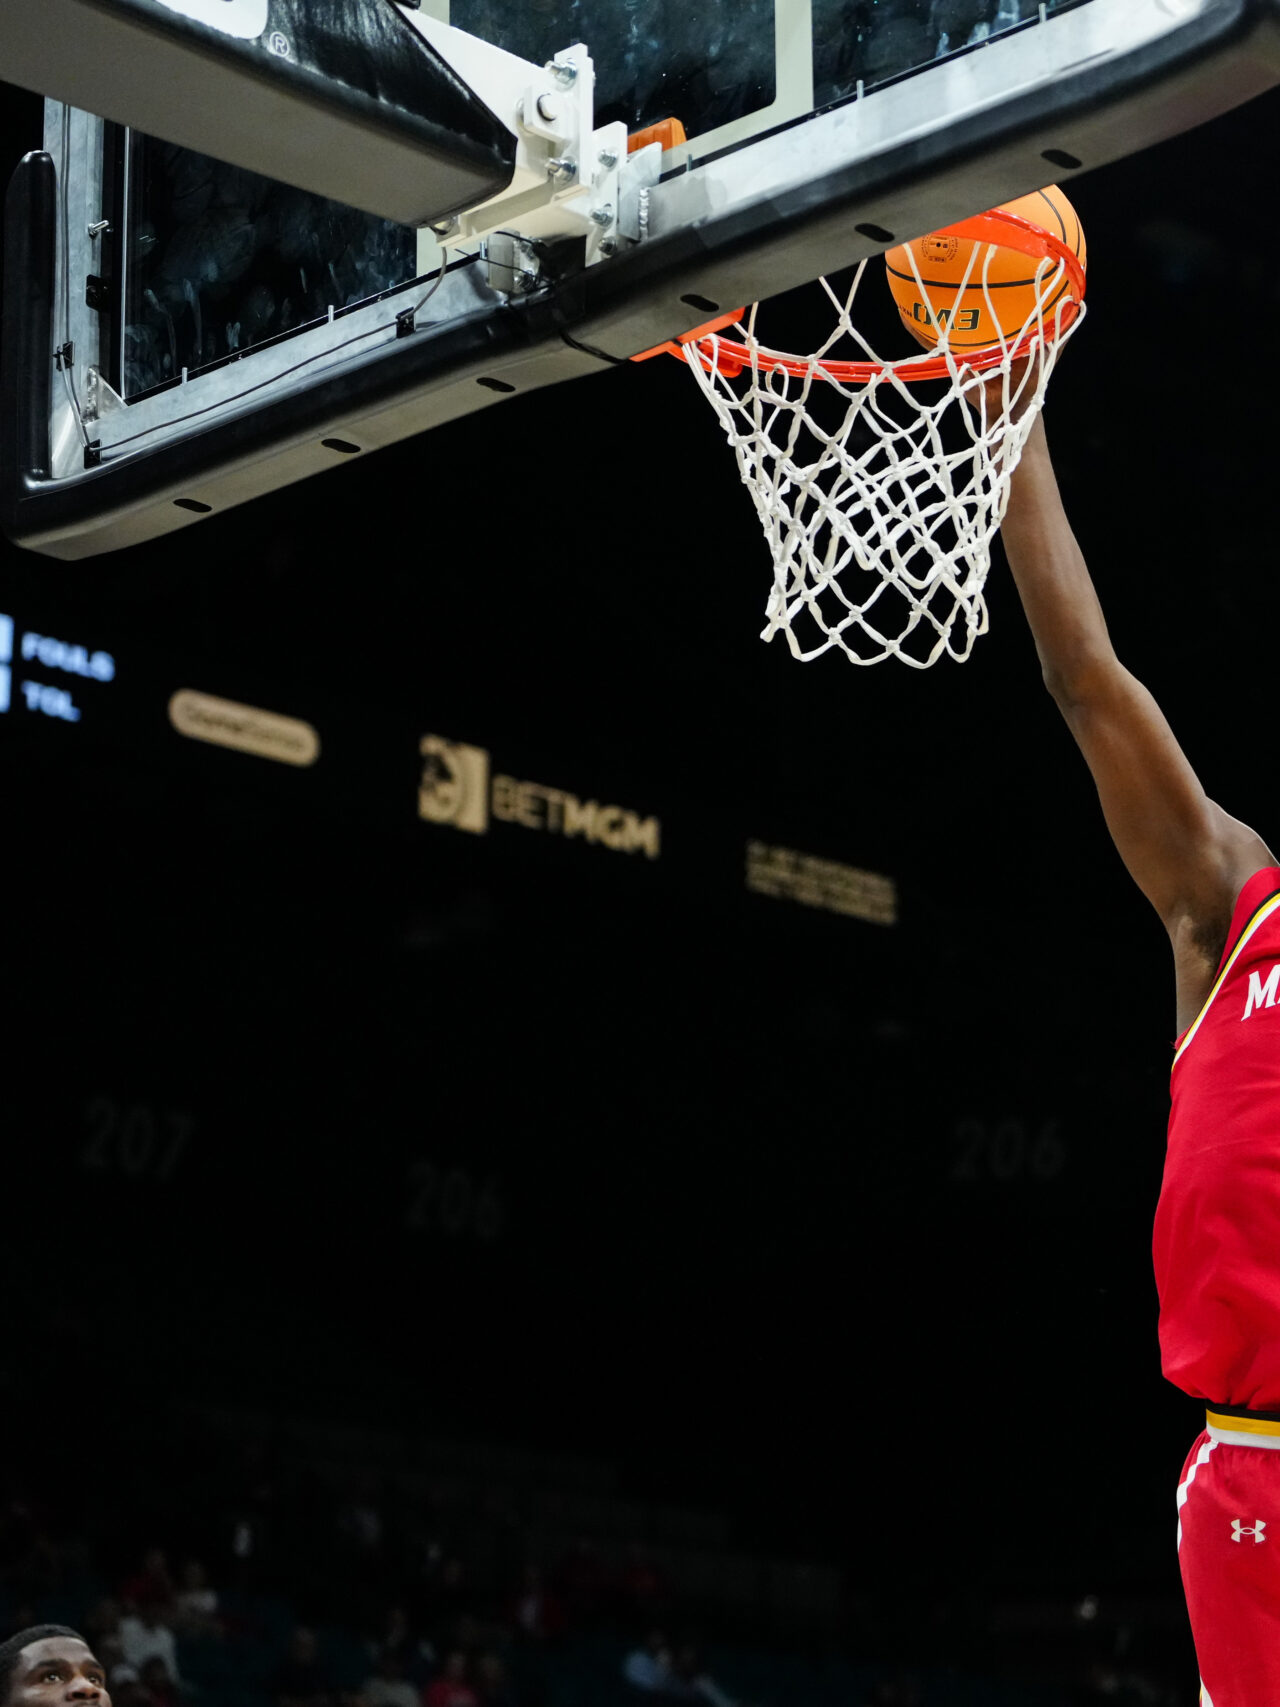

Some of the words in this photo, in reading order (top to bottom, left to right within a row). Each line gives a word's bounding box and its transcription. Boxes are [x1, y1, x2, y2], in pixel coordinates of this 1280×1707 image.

[21, 631, 115, 682] FOULS
[492, 773, 660, 860] BETMGM
[81, 1097, 194, 1180] 207
[951, 1117, 1066, 1181] 206
